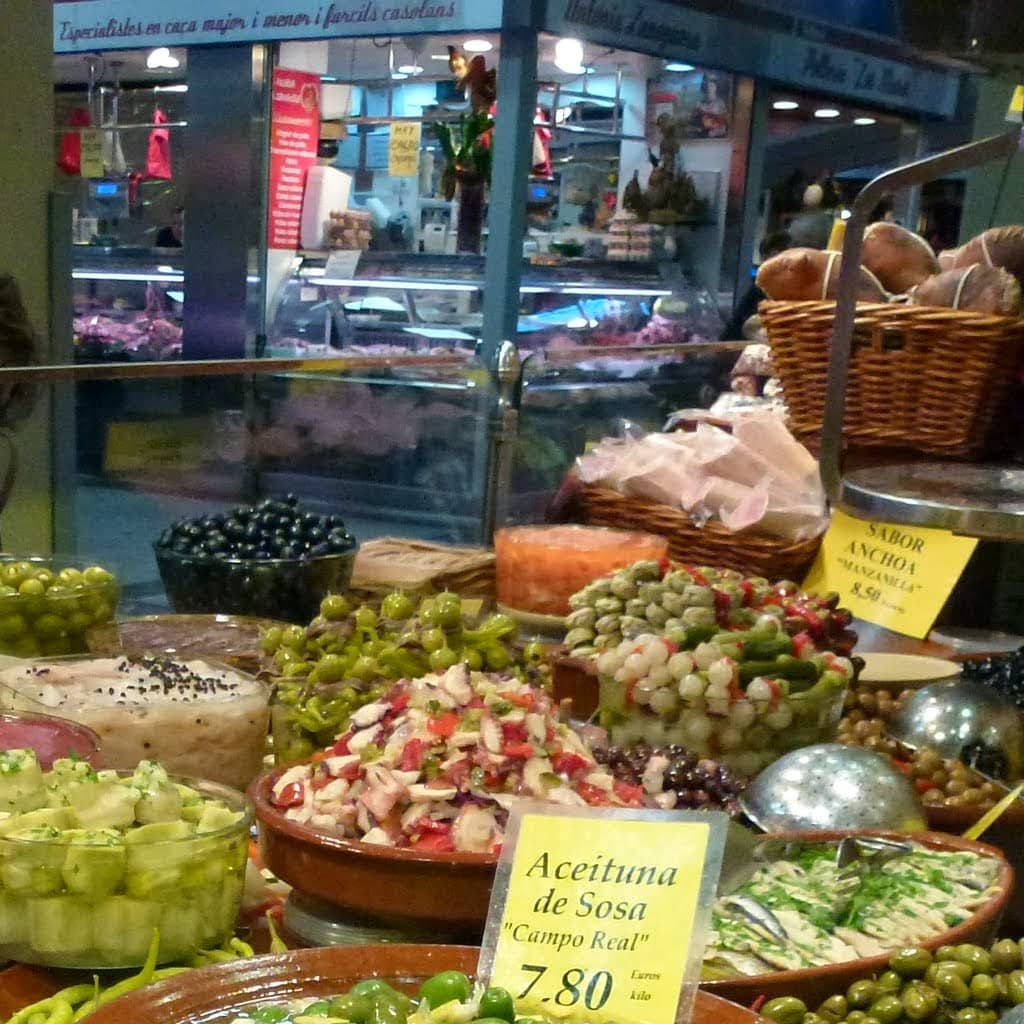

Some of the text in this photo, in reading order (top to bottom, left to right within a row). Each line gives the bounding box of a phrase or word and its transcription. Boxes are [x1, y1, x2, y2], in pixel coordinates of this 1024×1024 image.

[60, 18, 142, 43] Especialistes
[145, 23, 161, 36] en
[202, 13, 246, 35] major
[251, 11, 261, 28] i
[263, 14, 311, 28] menor
[382, 2, 456, 22] casolans
[867, 523, 925, 554] SABOR
[844, 540, 917, 576] ANCHOA
[526, 852, 678, 887] Aceituna
[533, 888, 647, 921] de Sosa
[504, 922, 650, 953] "Campo Real"
[516, 964, 661, 1011] 7.80 Euros
[630, 990, 652, 1002] kilo
